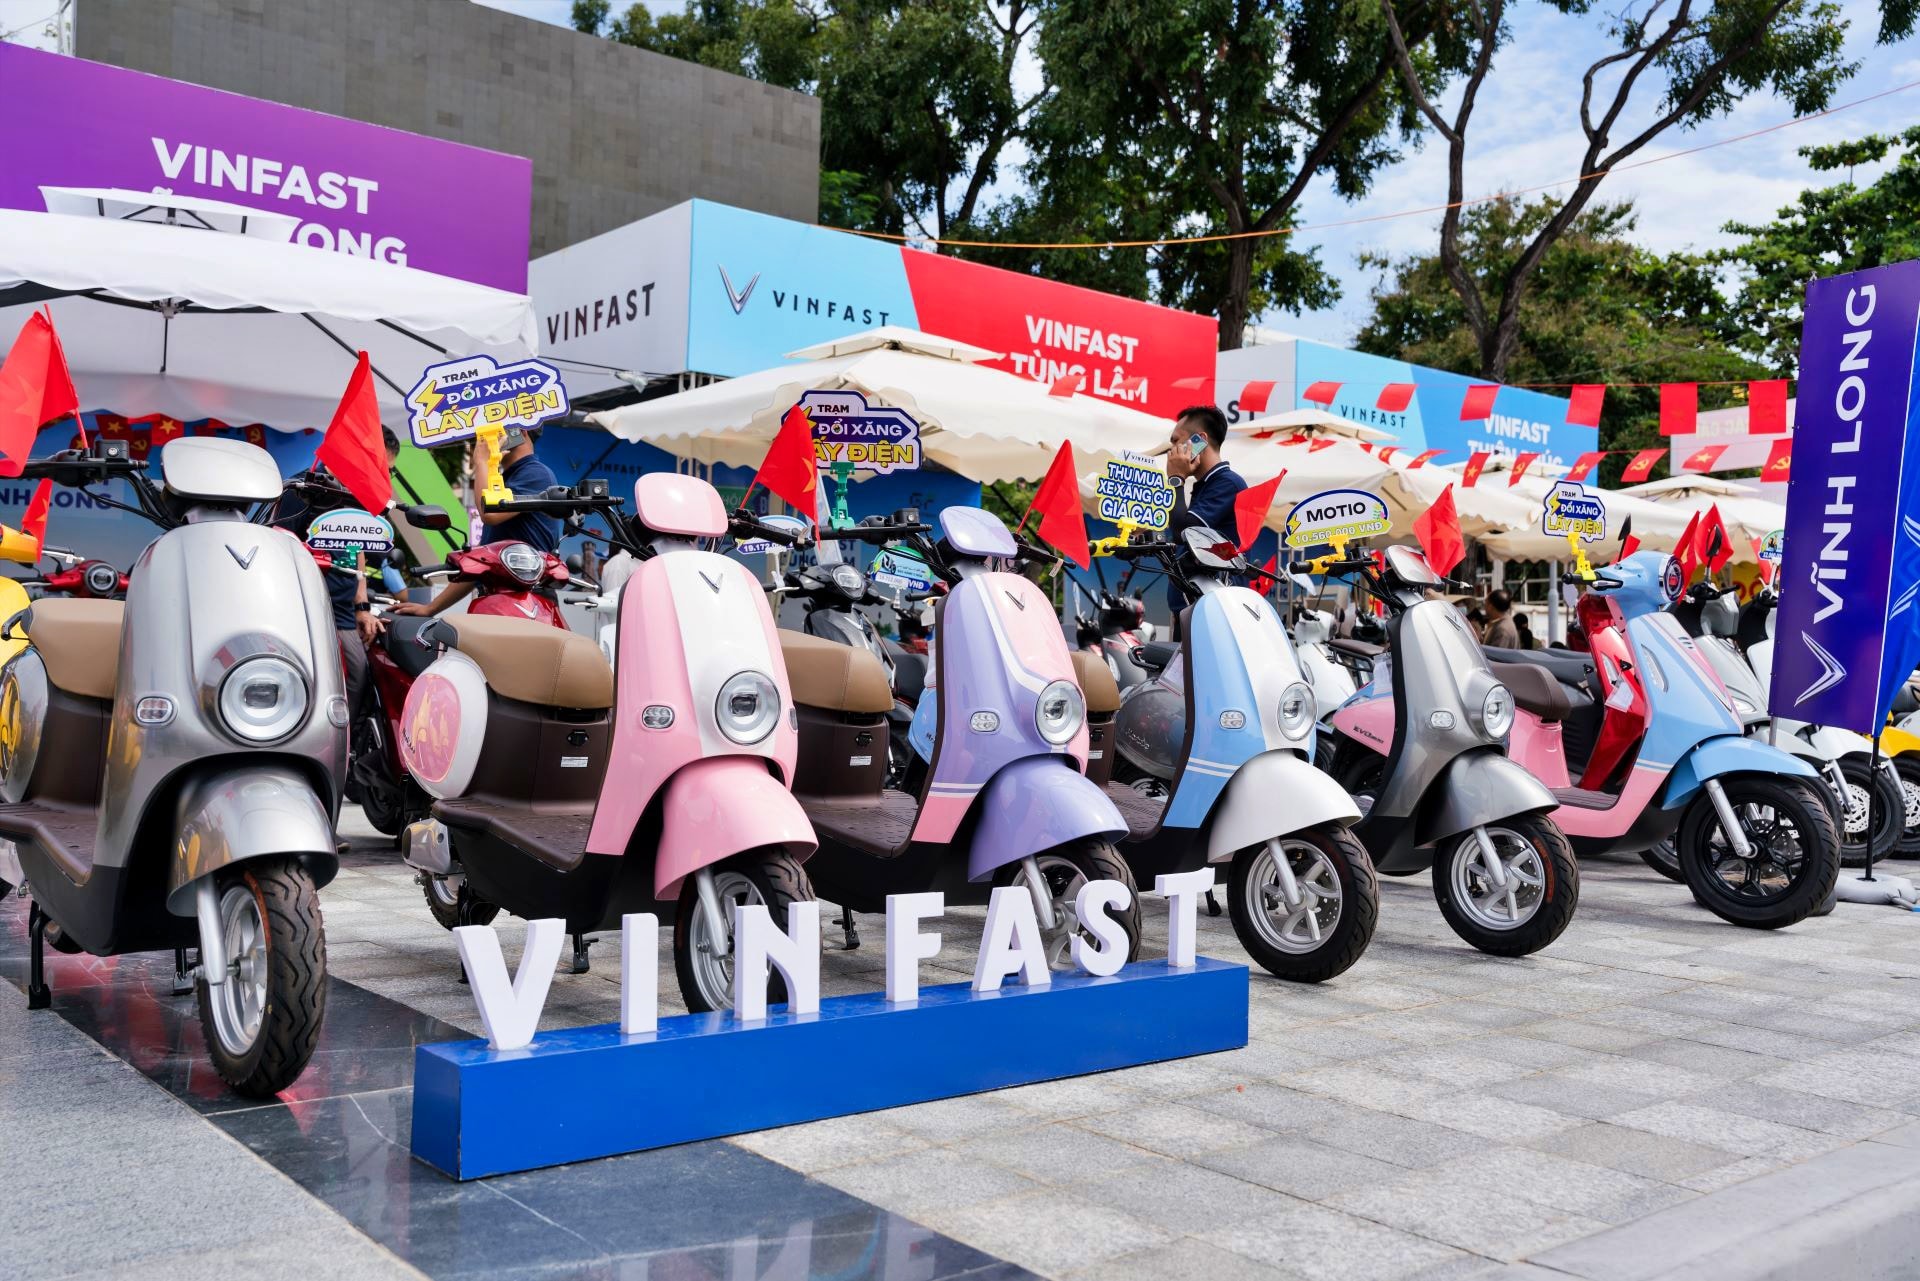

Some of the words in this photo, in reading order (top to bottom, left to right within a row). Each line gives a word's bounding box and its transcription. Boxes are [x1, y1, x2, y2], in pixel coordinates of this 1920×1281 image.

[151, 137, 379, 214] VINFAST
[296, 222, 408, 267] ONG
[547, 282, 655, 345] VINFAST
[773, 290, 890, 327] VINFAST
[1025, 315, 1139, 363] VINFAST
[442, 368, 479, 383] TRẠM
[1831, 284, 1876, 454] LONG
[484, 374, 542, 397] XĂNG
[418, 403, 478, 438] LẤY
[484, 390, 560, 423] ĐIỆN
[817, 404, 850, 415] TRẠM
[1341, 404, 1407, 429] VINFAST
[851, 421, 903, 436] XĂNG
[1484, 413, 1551, 445] VINFAST
[814, 435, 844, 461] ẤY
[847, 439, 914, 468] ĐIỆN
[1108, 462, 1133, 481] THU
[1134, 470, 1164, 488] MUA
[49, 491, 113, 510] ONG
[1098, 479, 1114, 495] XE
[1115, 482, 1152, 503] XĂNG
[1153, 490, 1173, 507] CŨ
[1101, 498, 1129, 519] GIÁ
[1131, 504, 1166, 526] CAO
[1306, 502, 1366, 522] MOTIO
[1575, 504, 1599, 516] XĂNG
[321, 524, 358, 533] KLARA
[360, 526, 383, 535] NEO
[1359, 521, 1383, 533] VNĐ
[1547, 513, 1572, 531] LẤY
[1573, 518, 1603, 537] ĐIỆN
[1810, 476, 1857, 624] VĨNH
[452, 867, 1215, 1050] VINFAST
